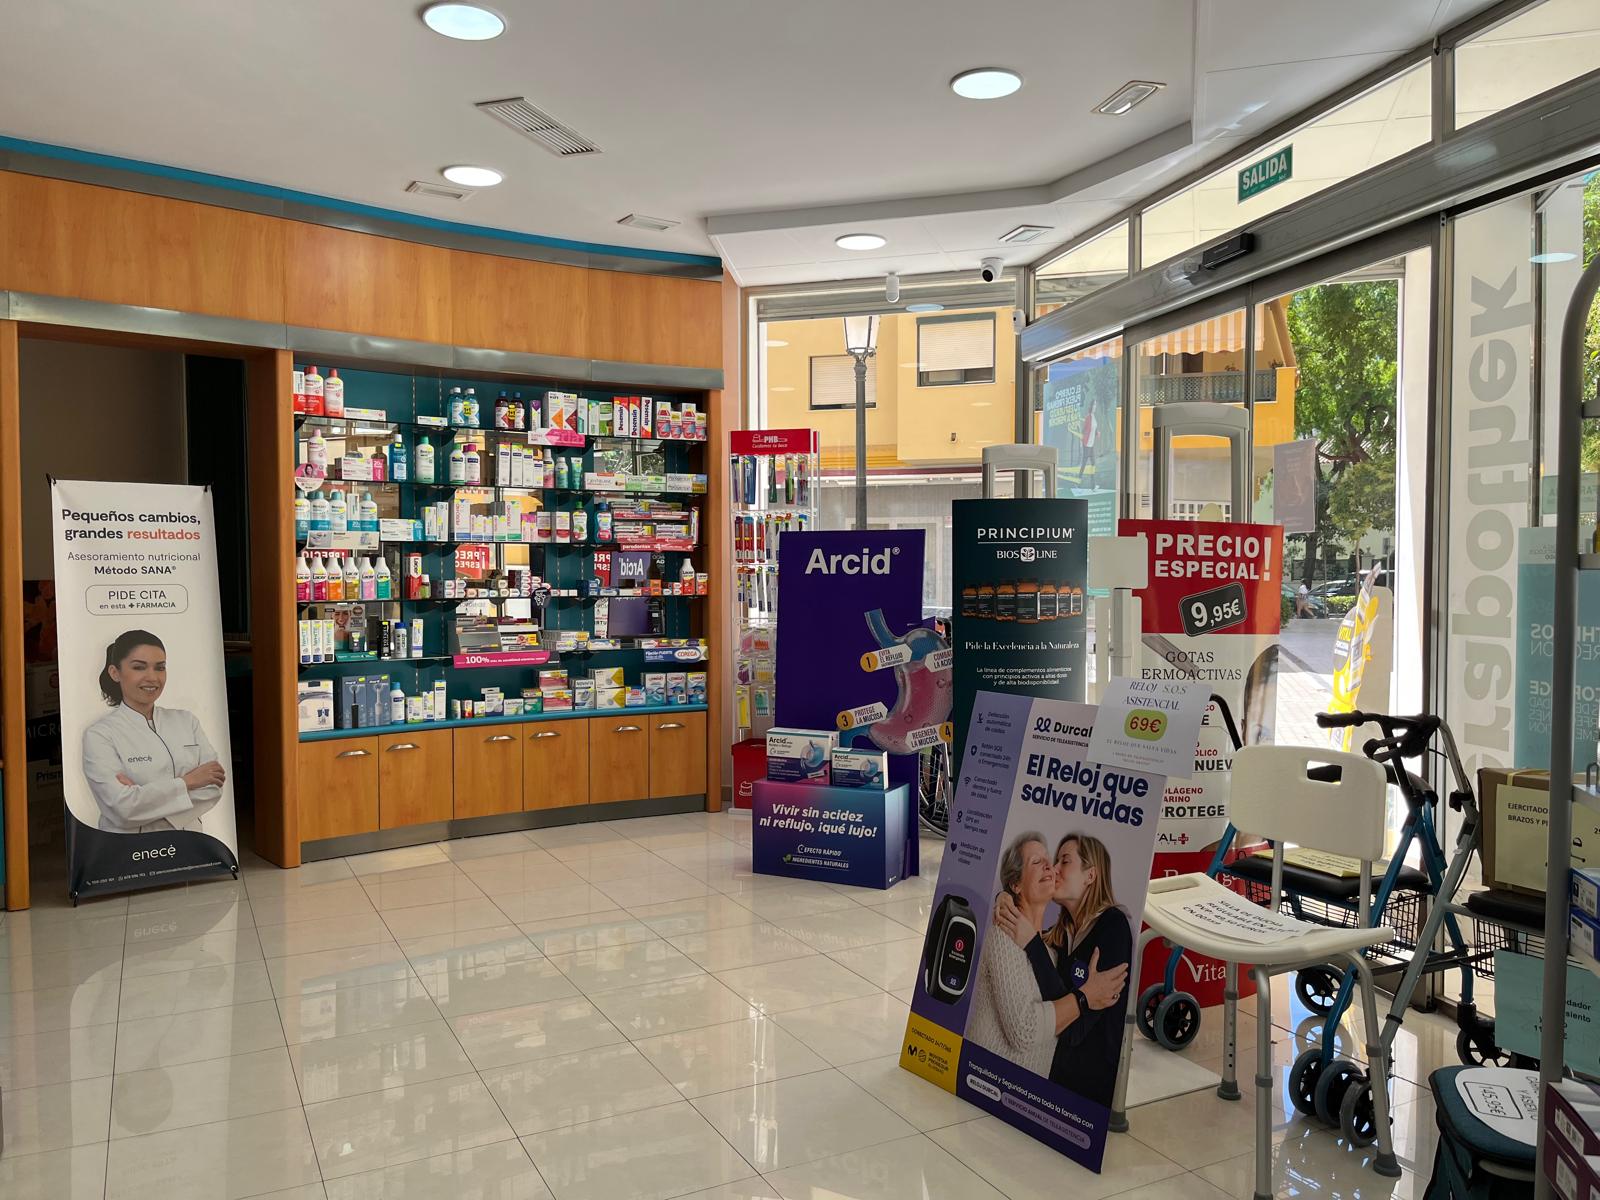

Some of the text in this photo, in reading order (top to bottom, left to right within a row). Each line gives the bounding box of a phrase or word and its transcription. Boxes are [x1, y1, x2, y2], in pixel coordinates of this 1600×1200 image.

[1242, 153, 1288, 190] SALIDA
[62, 509, 200, 525] Pequeños cambios,
[65, 527, 200, 540] grandes resultados
[1156, 534, 1260, 558] PRECIO
[68, 552, 200, 561] Asesoramiento nutricional
[996, 550, 1057, 559] BIOS LINE
[94, 566, 138, 575] Método
[108, 590, 166, 600] PIDE CITA
[1191, 599, 1241, 627] 9,95€
[965, 642, 982, 650] Pide
[984, 642, 991, 650] la
[993, 642, 1034, 650] Excelencia
[1049, 641, 1080, 649] Naturaleza
[885, 653, 903, 662] REFLUJO
[1165, 652, 1214, 663] GOTAS
[1130, 681, 1158, 693] RELOJ
[1123, 696, 1180, 710] ASISTENCIAL
[854, 706, 875, 717] PROTEGE
[863, 712, 883, 723] MUCOSA
[842, 715, 848, 727] 3
[1130, 716, 1161, 733] 69€
[912, 728, 938, 739] REGENERA
[1054, 722, 1093, 738] Durcal
[920, 736, 938, 747] MUCOSA
[974, 776, 998, 786] Conectado
[1026, 754, 1045, 776] El
[1046, 757, 1101, 793] Reloj
[1103, 772, 1148, 797] que
[1021, 783, 1144, 826] salva vidas
[772, 804, 863, 822] Vivir sin acidez
[1162, 805, 1225, 818] ROTEGE
[1508, 814, 1534, 824] BRAZOS
[760, 816, 877, 838] ni reflujo, ¡qué lujo!
[823, 847, 841, 856] RÁPIDO
[792, 857, 849, 868] INGREDIENTES NATURALES
[968, 1061, 998, 1081] Tranquilidad
[1002, 1078, 1027, 1096] Seguridad
[1028, 1092, 1041, 1103] para
[1042, 1099, 1055, 1110] toda
[1055, 1105, 1061, 1113] la
[1061, 1108, 1081, 1124] familia
[1082, 1119, 1094, 1129] con
